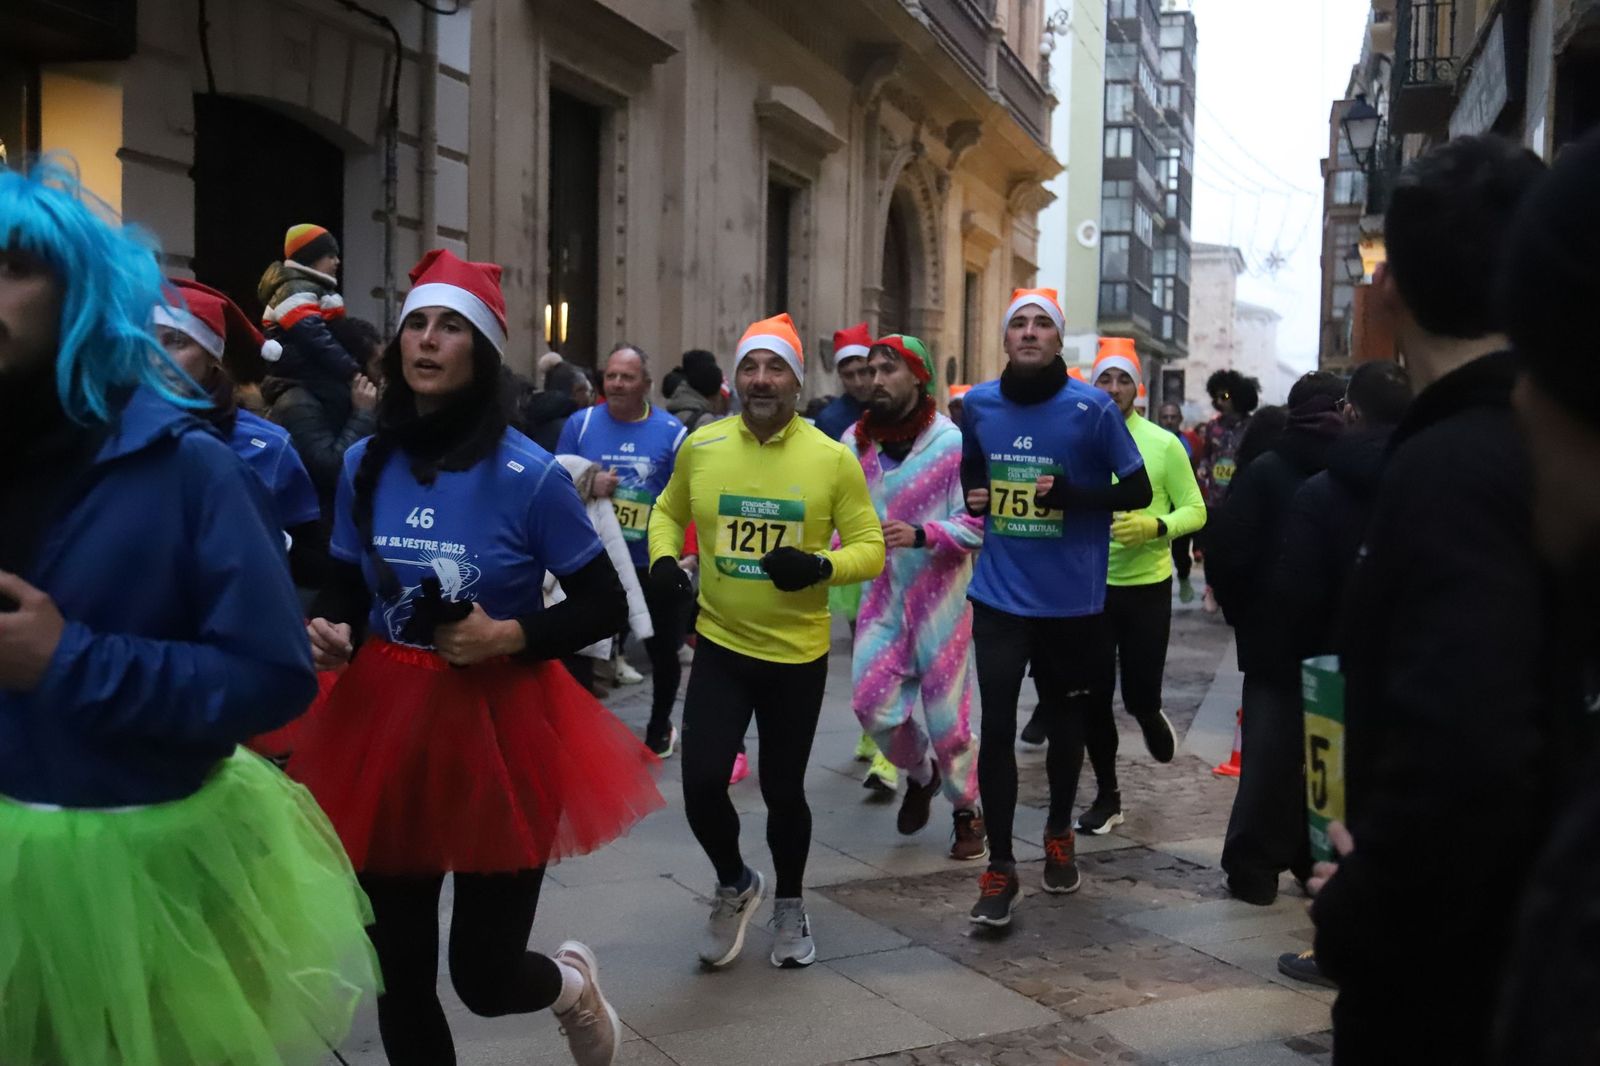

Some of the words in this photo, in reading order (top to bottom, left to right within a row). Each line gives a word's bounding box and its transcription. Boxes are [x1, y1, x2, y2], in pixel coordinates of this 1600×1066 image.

[619, 442, 635, 453] 46
[1012, 435, 1033, 450] 46
[405, 506, 435, 530] 46
[1007, 523, 1027, 532] CAJA
[1029, 524, 1058, 533] RURAL
[372, 534, 388, 547] SAN
[388, 536, 439, 552] SILVESTRE
[440, 541, 467, 555] 2025
[727, 519, 788, 555] 1217
[738, 564, 762, 575] CAJA
